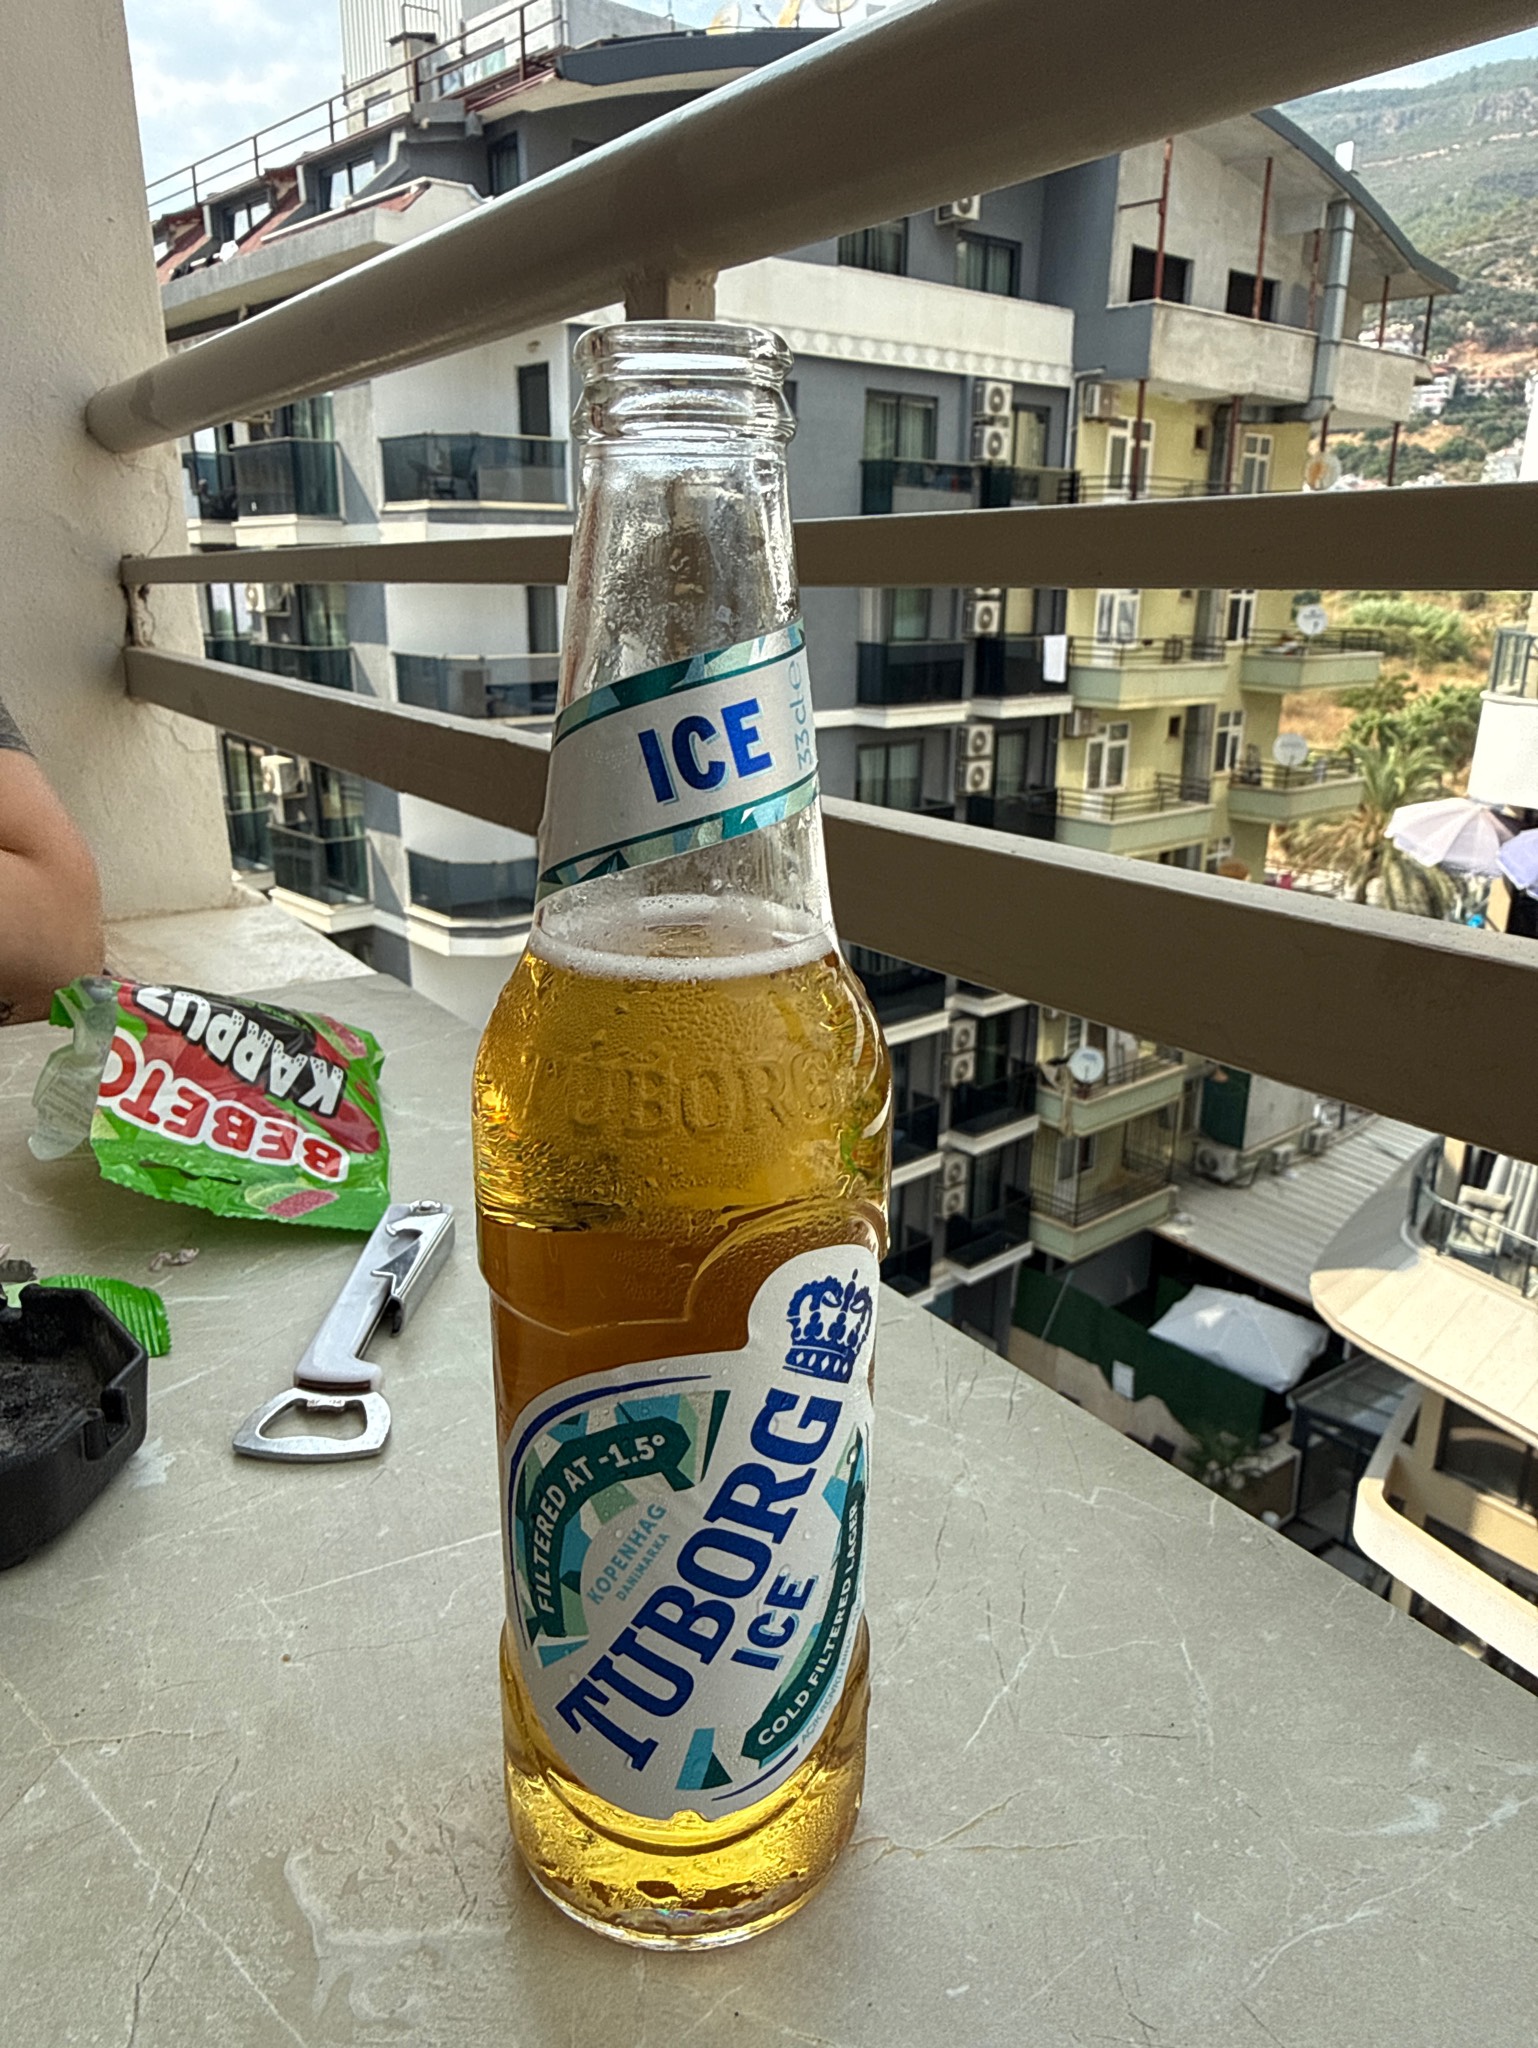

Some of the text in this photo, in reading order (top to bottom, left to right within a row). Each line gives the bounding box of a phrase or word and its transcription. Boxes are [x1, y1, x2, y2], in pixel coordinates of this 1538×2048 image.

[637, 697, 776, 806] ICE
[136, 986, 345, 1116] KARPUZ
[533, 1484, 567, 1614] FILTERED
[563, 1455, 594, 1494] AT
[555, 1387, 843, 1772] TUBORG
[587, 1503, 667, 1605] KOPENHAG
[730, 1572, 819, 1671] ICE
[757, 1688, 811, 1746] COLD
[807, 1577, 852, 1688] FILTERED
[844, 1500, 858, 1575] LAGER
